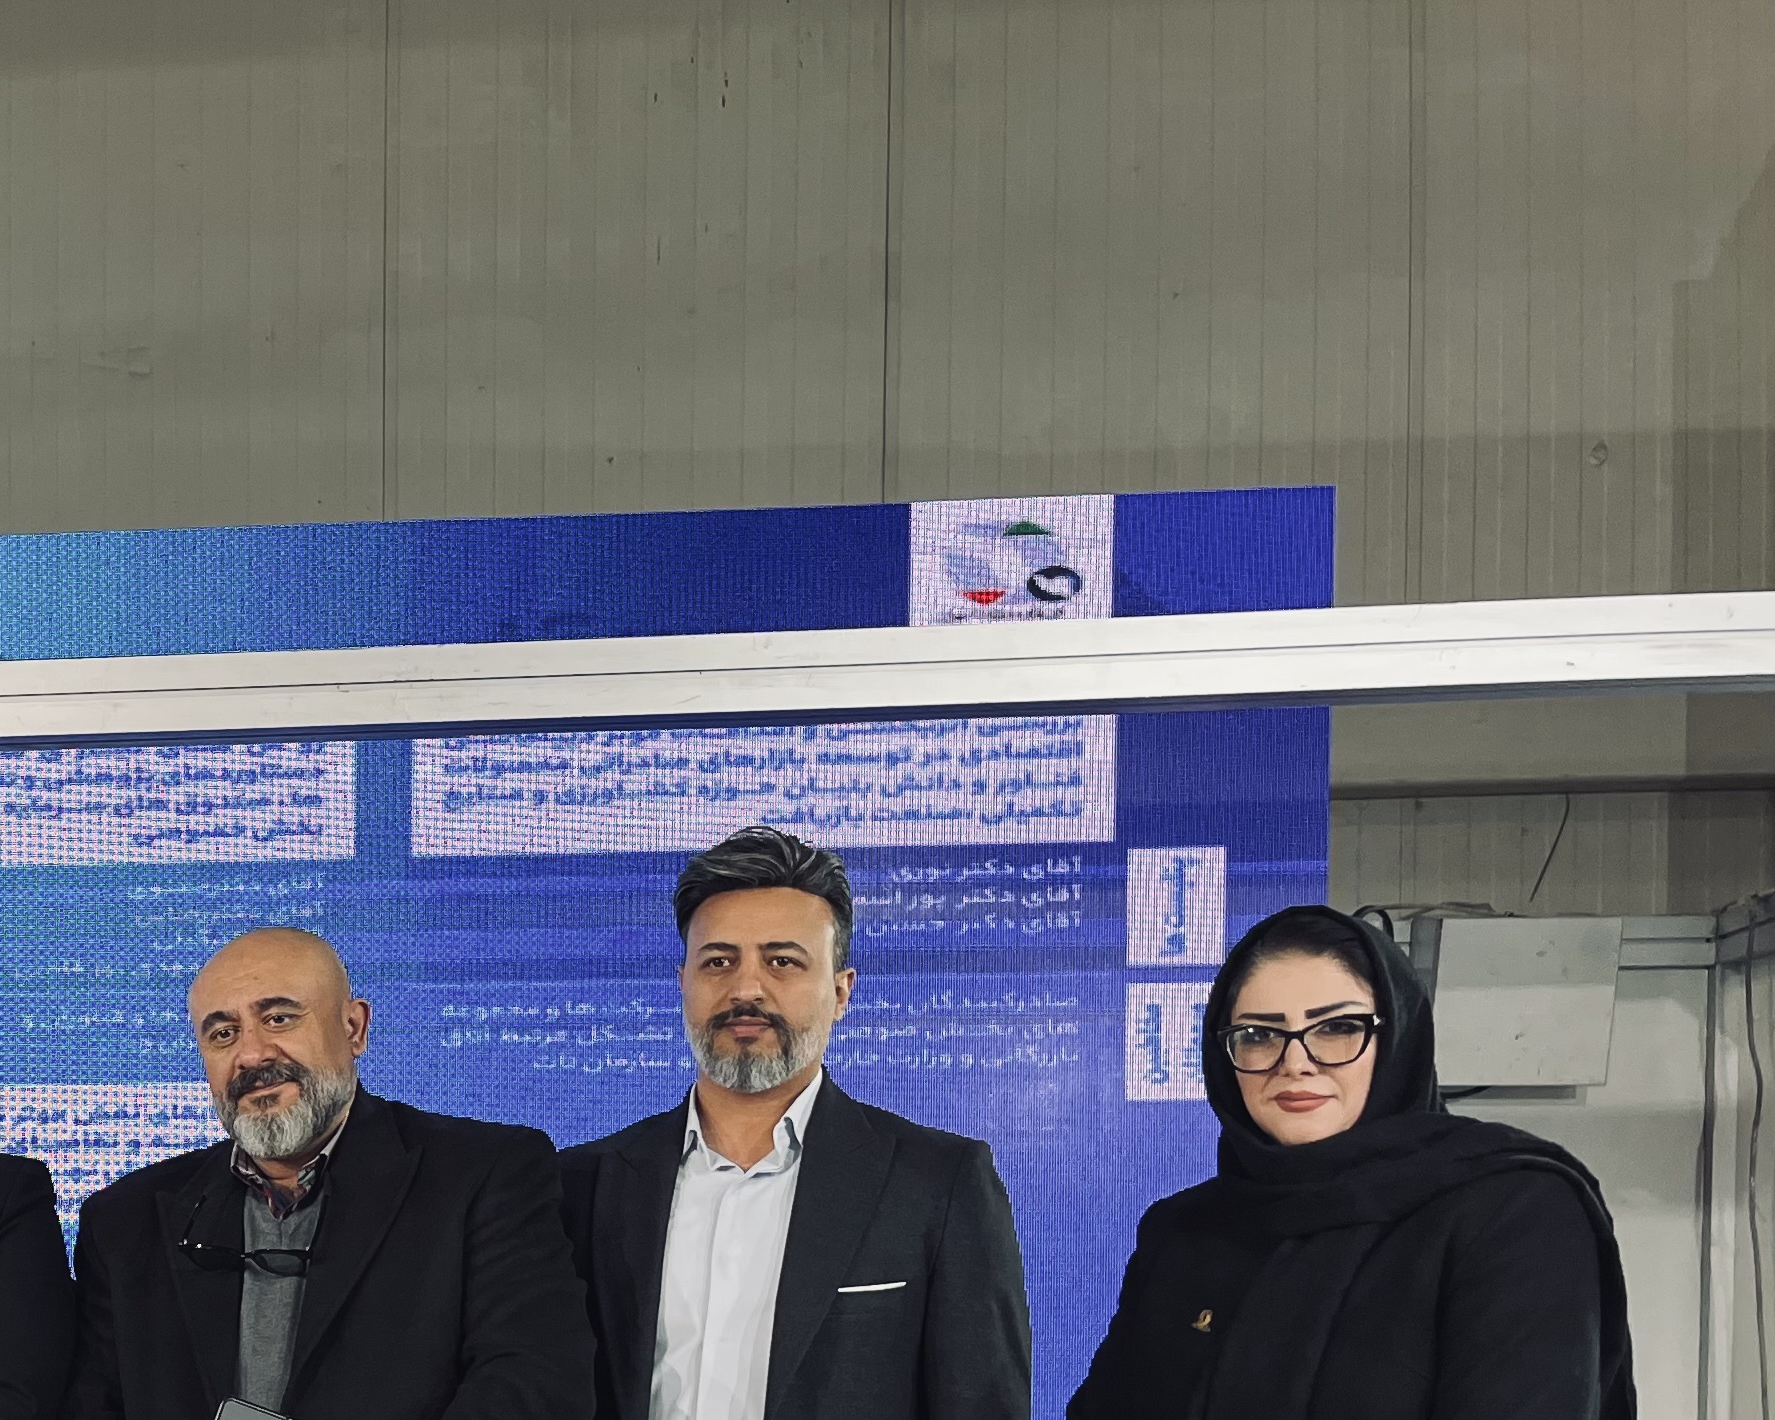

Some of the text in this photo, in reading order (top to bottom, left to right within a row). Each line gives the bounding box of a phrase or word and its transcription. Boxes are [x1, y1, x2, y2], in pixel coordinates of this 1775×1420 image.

[955, 858, 1016, 882] دکتر
[1021, 855, 1082, 882] آقای
[955, 887, 1016, 910] دکتر
[1021, 884, 1082, 909] آقای
[955, 913, 1016, 935] دکتر
[1021, 911, 1082, 935] آقای
